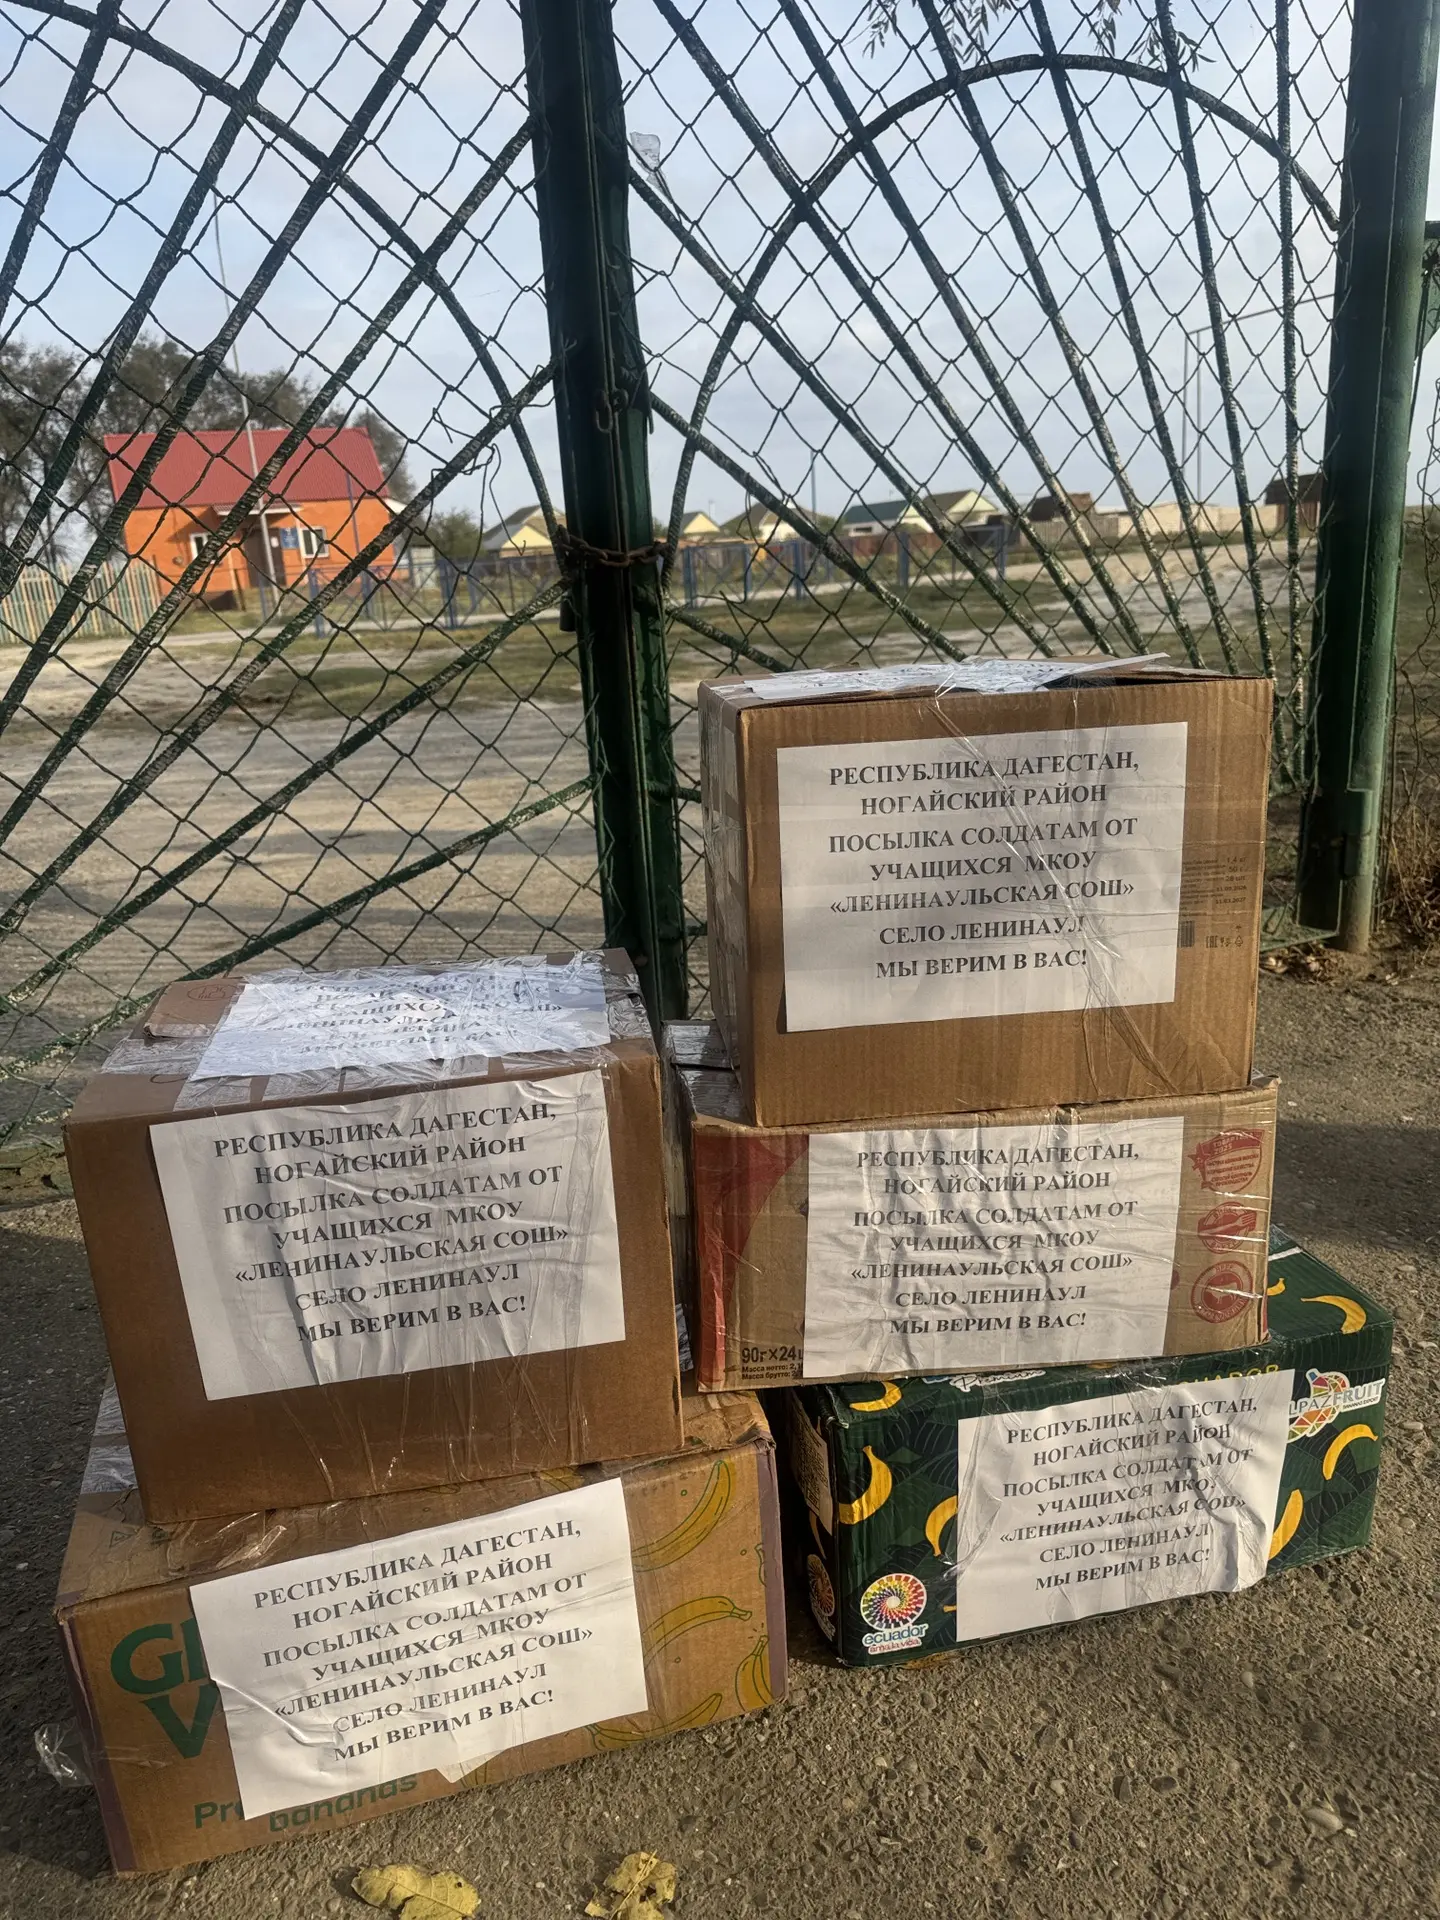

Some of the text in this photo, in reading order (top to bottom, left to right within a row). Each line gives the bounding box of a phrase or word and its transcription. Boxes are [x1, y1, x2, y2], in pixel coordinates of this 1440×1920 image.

[830, 751, 1139, 786] РЕСПУБЛИКА ДАГЕСТАН,
[861, 781, 1106, 815] НОГАЙСКИЙ РАЙОН
[829, 817, 1138, 853] ПОСЫЛКА СОЛДАТАМ ОТ
[870, 850, 1097, 882] УЧАЩИХСЯ МКОУ
[831, 879, 1133, 914] «ЛЕНИНАУЛЬСКАЯ СОШ»
[879, 917, 1084, 945] СЕЛО ЛЕНИНАУЛ
[876, 948, 1088, 978] МЫ ВЕРИМ В ВАС!
[215, 1104, 556, 1157] РЕСПУБЛИКА ДАГЕСТАН,
[255, 1136, 526, 1184] НОГАЙСКИЙ РАЙОН
[858, 1144, 1138, 1168] РЕСПУБЛИКА ДАГЕСТАН,
[223, 1166, 563, 1224] ПОСЫЛКА СОЛДАТАМ ОТ
[884, 1170, 1110, 1194] НОГАЙСКИЙ РАЙОН
[274, 1201, 524, 1249] УЧАЩИХСЯ МКОУ
[854, 1200, 1138, 1227] ПОСЫЛКА СОЛДАТАМ ОТ
[235, 1225, 567, 1282] «ЛЕНИНАУЛЬСКАЯ СОШ»
[890, 1230, 1100, 1253] УЧАЩИХСЯ МКОУ
[295, 1263, 519, 1312] СЕЛО ЛЕНИНАУЛ
[852, 1253, 1132, 1281] «ЛЕНИНАУЛЬСКАЯ СОШ»
[896, 1285, 1086, 1306] СЕЛО ЛЕНИНАУЛ
[297, 1296, 526, 1343] МЫ ВЕРИМ В ВАС!
[890, 1312, 1086, 1336] МЫ ВЕРИМ В ВАС!
[742, 1364, 765, 1373] Масса
[742, 1372, 765, 1380] Масса
[1007, 1398, 1257, 1445] РЕСПУБЛИКА ДАГЕСТАН,
[1034, 1422, 1231, 1466] НОГАЙСКИЙ РАЙОН
[1003, 1470, 1107, 1498] ПОСЫЛКА
[1230, 1448, 1253, 1467] ОТ
[1000, 1500, 1189, 1542] «ЛЕНИНАУЛЬСКАЯ
[1037, 1486, 1153, 1517] УЧАЩИХСЯ
[254, 1521, 582, 1608] РЕСПУБЛИКА ДАГЕСТАН,
[1040, 1524, 1210, 1563] СЕЛО ЛЕНИНАУЛ
[294, 1553, 552, 1629] НОГАЙСКИЙ РАЙОН
[1035, 1549, 1210, 1591] МЫ ВЕРИМ В ВАС!
[263, 1573, 587, 1667] ПОСЫЛКА СОЛДАТАМ ОТ
[864, 1625, 927, 1645] ecuador
[313, 1607, 551, 1681] УЧАЩИХСЯ МКОУ
[275, 1629, 593, 1716] «ЛЕНИНАУЛЬСКАЯ СОШ»
[334, 1664, 548, 1734] СЕЛО ЛЕНИНАУЛ
[333, 1689, 554, 1762] МЫ ВЕРИМ В ВАС!
[269, 1774, 418, 1833] bananas
